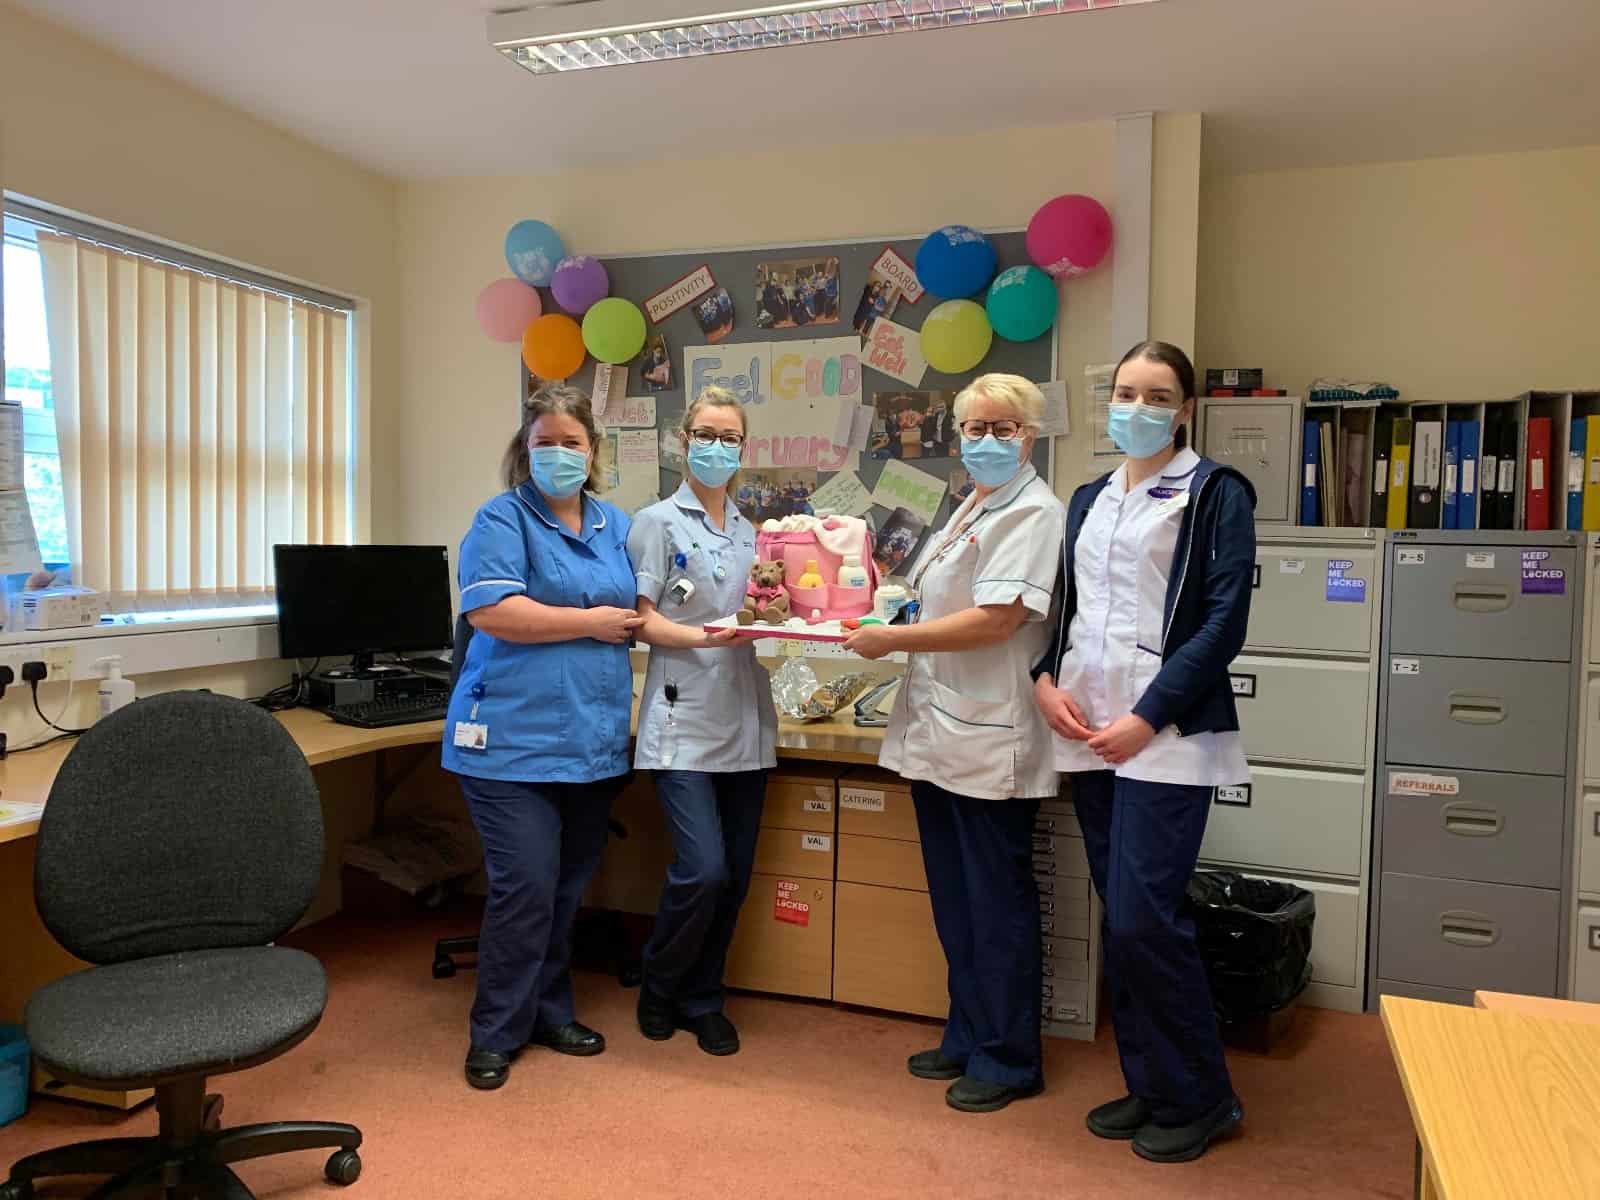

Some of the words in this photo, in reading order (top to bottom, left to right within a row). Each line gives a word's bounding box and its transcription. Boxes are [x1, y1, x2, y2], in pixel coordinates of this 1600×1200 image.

[880, 257, 918, 293] BOARD
[651, 274, 706, 314] POSITIVITY
[691, 356, 766, 405] Feel
[771, 353, 861, 400] GOOD
[1522, 551, 1549, 560] KEEP
[1328, 560, 1353, 569] KEEP
[1522, 560, 1539, 569] ME
[1328, 569, 1344, 578] ME
[1522, 570, 1564, 579] LOCKED
[1328, 578, 1365, 588] LOCKED
[1394, 778, 1457, 793] REFERRALS
[842, 794, 881, 807] CATERING
[810, 802, 826, 810] VAL
[807, 837, 824, 846] VAL
[777, 881, 800, 892] KEEP
[777, 890, 791, 900] ME
[776, 899, 809, 912] LOCKED
